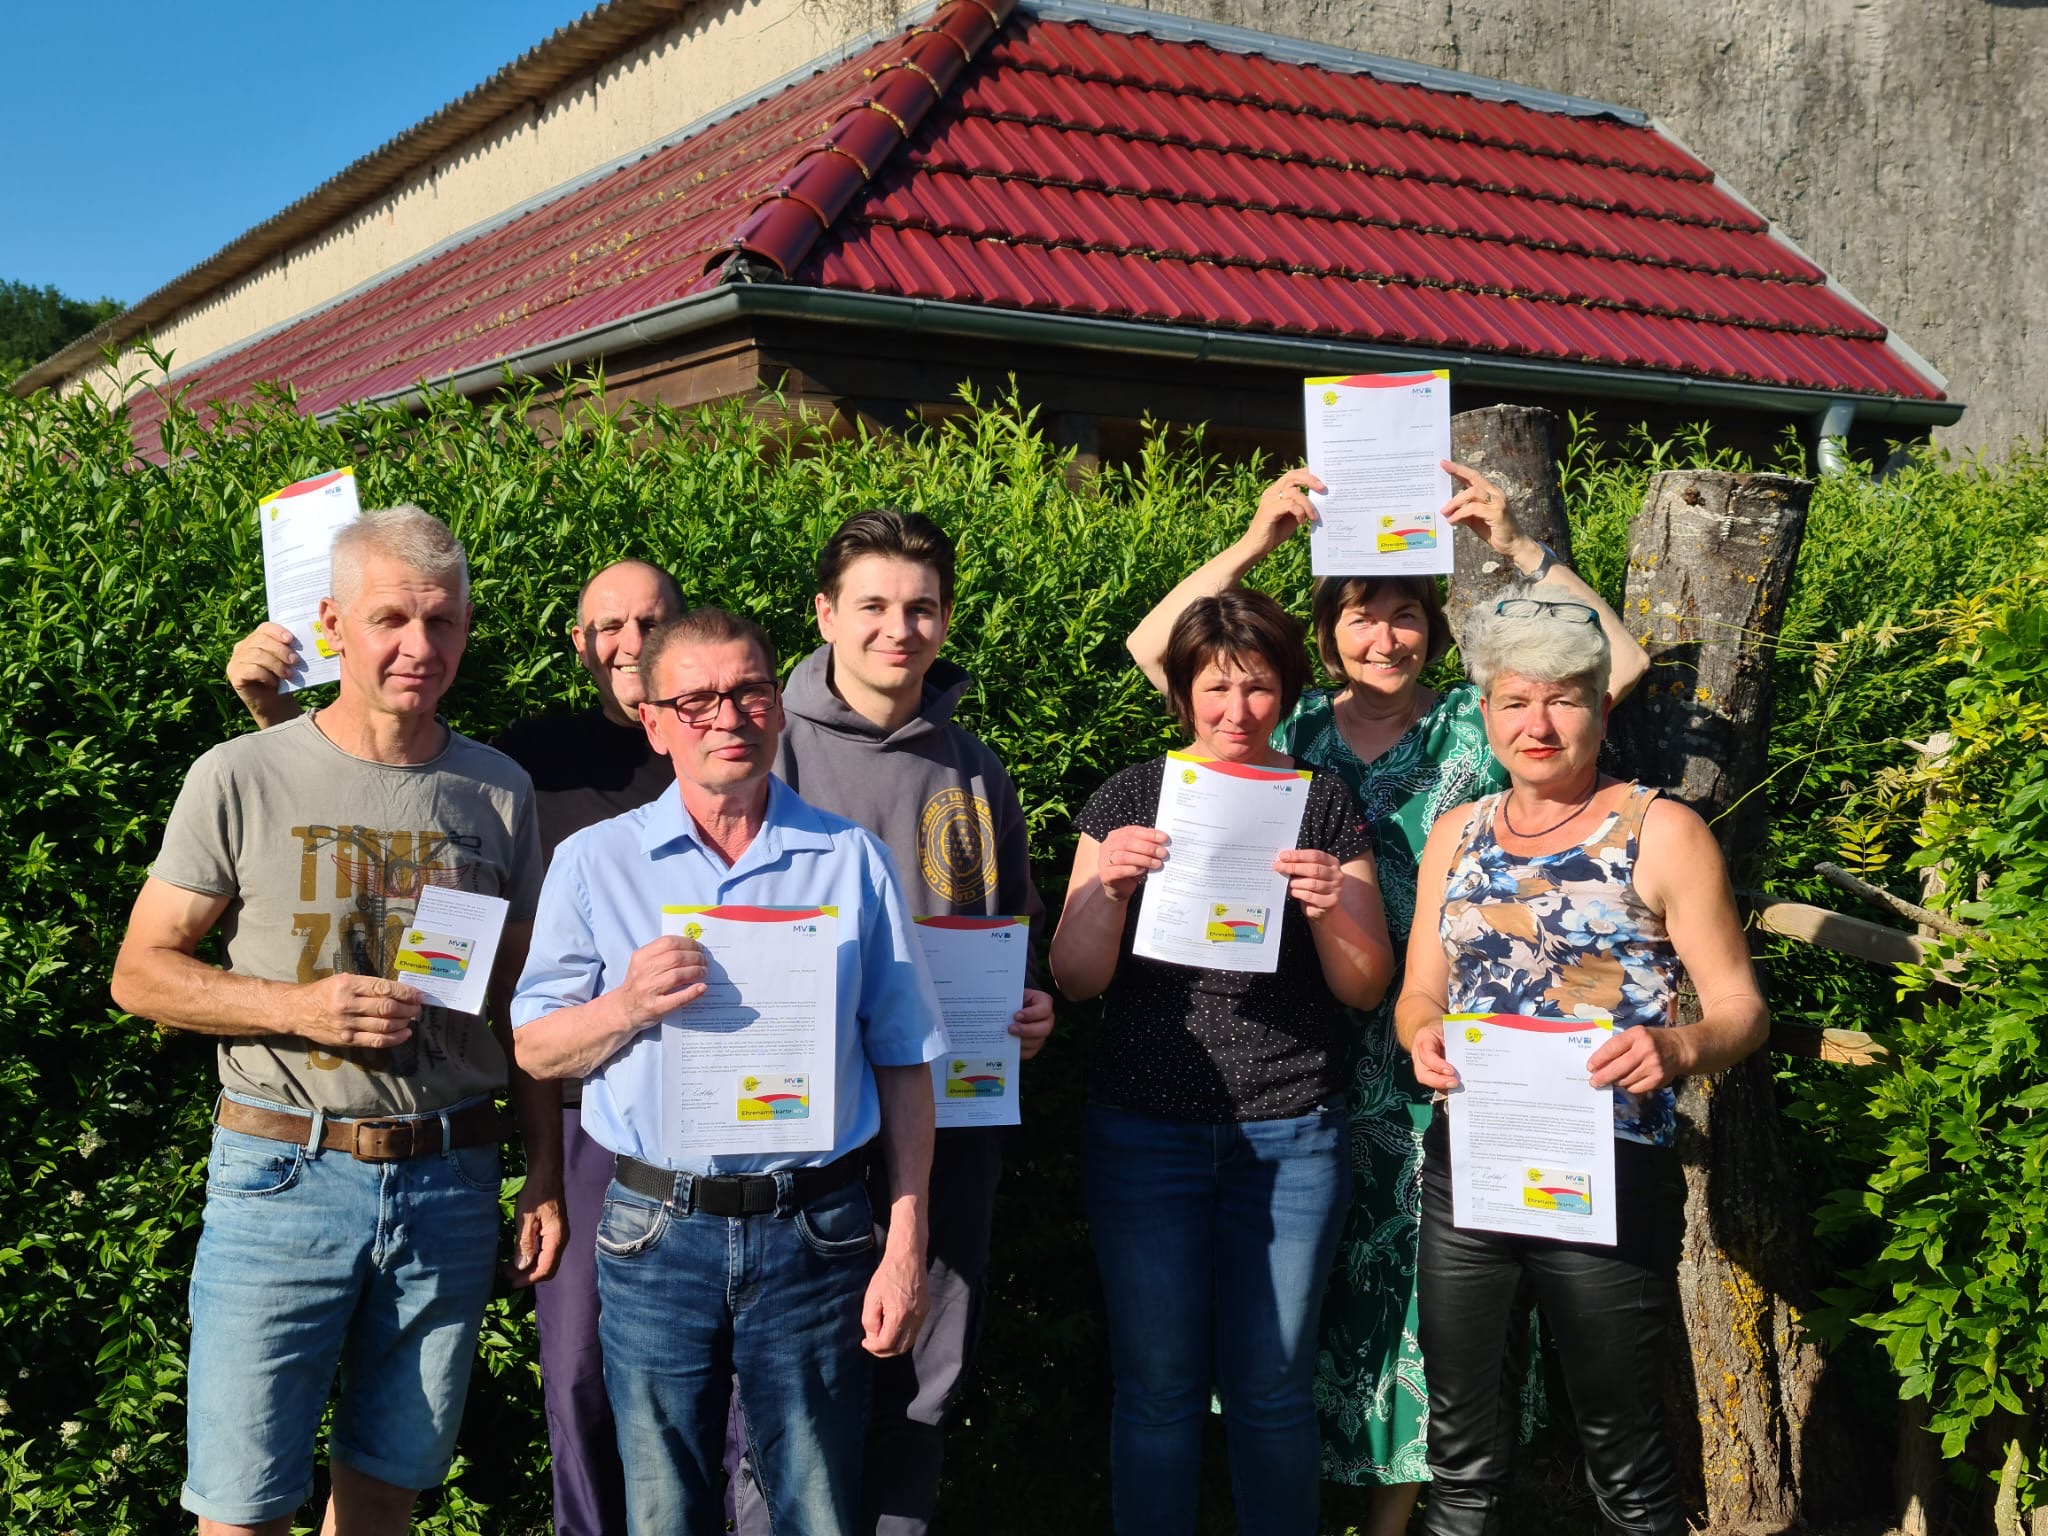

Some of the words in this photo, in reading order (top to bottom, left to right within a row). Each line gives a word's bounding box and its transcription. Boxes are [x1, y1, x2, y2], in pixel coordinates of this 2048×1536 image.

[793, 925, 808, 933] MV
[399, 960, 449, 973] Ehrenamtskarte
[1568, 1036, 1583, 1044] MV
[741, 1108, 792, 1116] Ehrenamtskarte
[1527, 1197, 1575, 1208] Ehrenamtskarte
